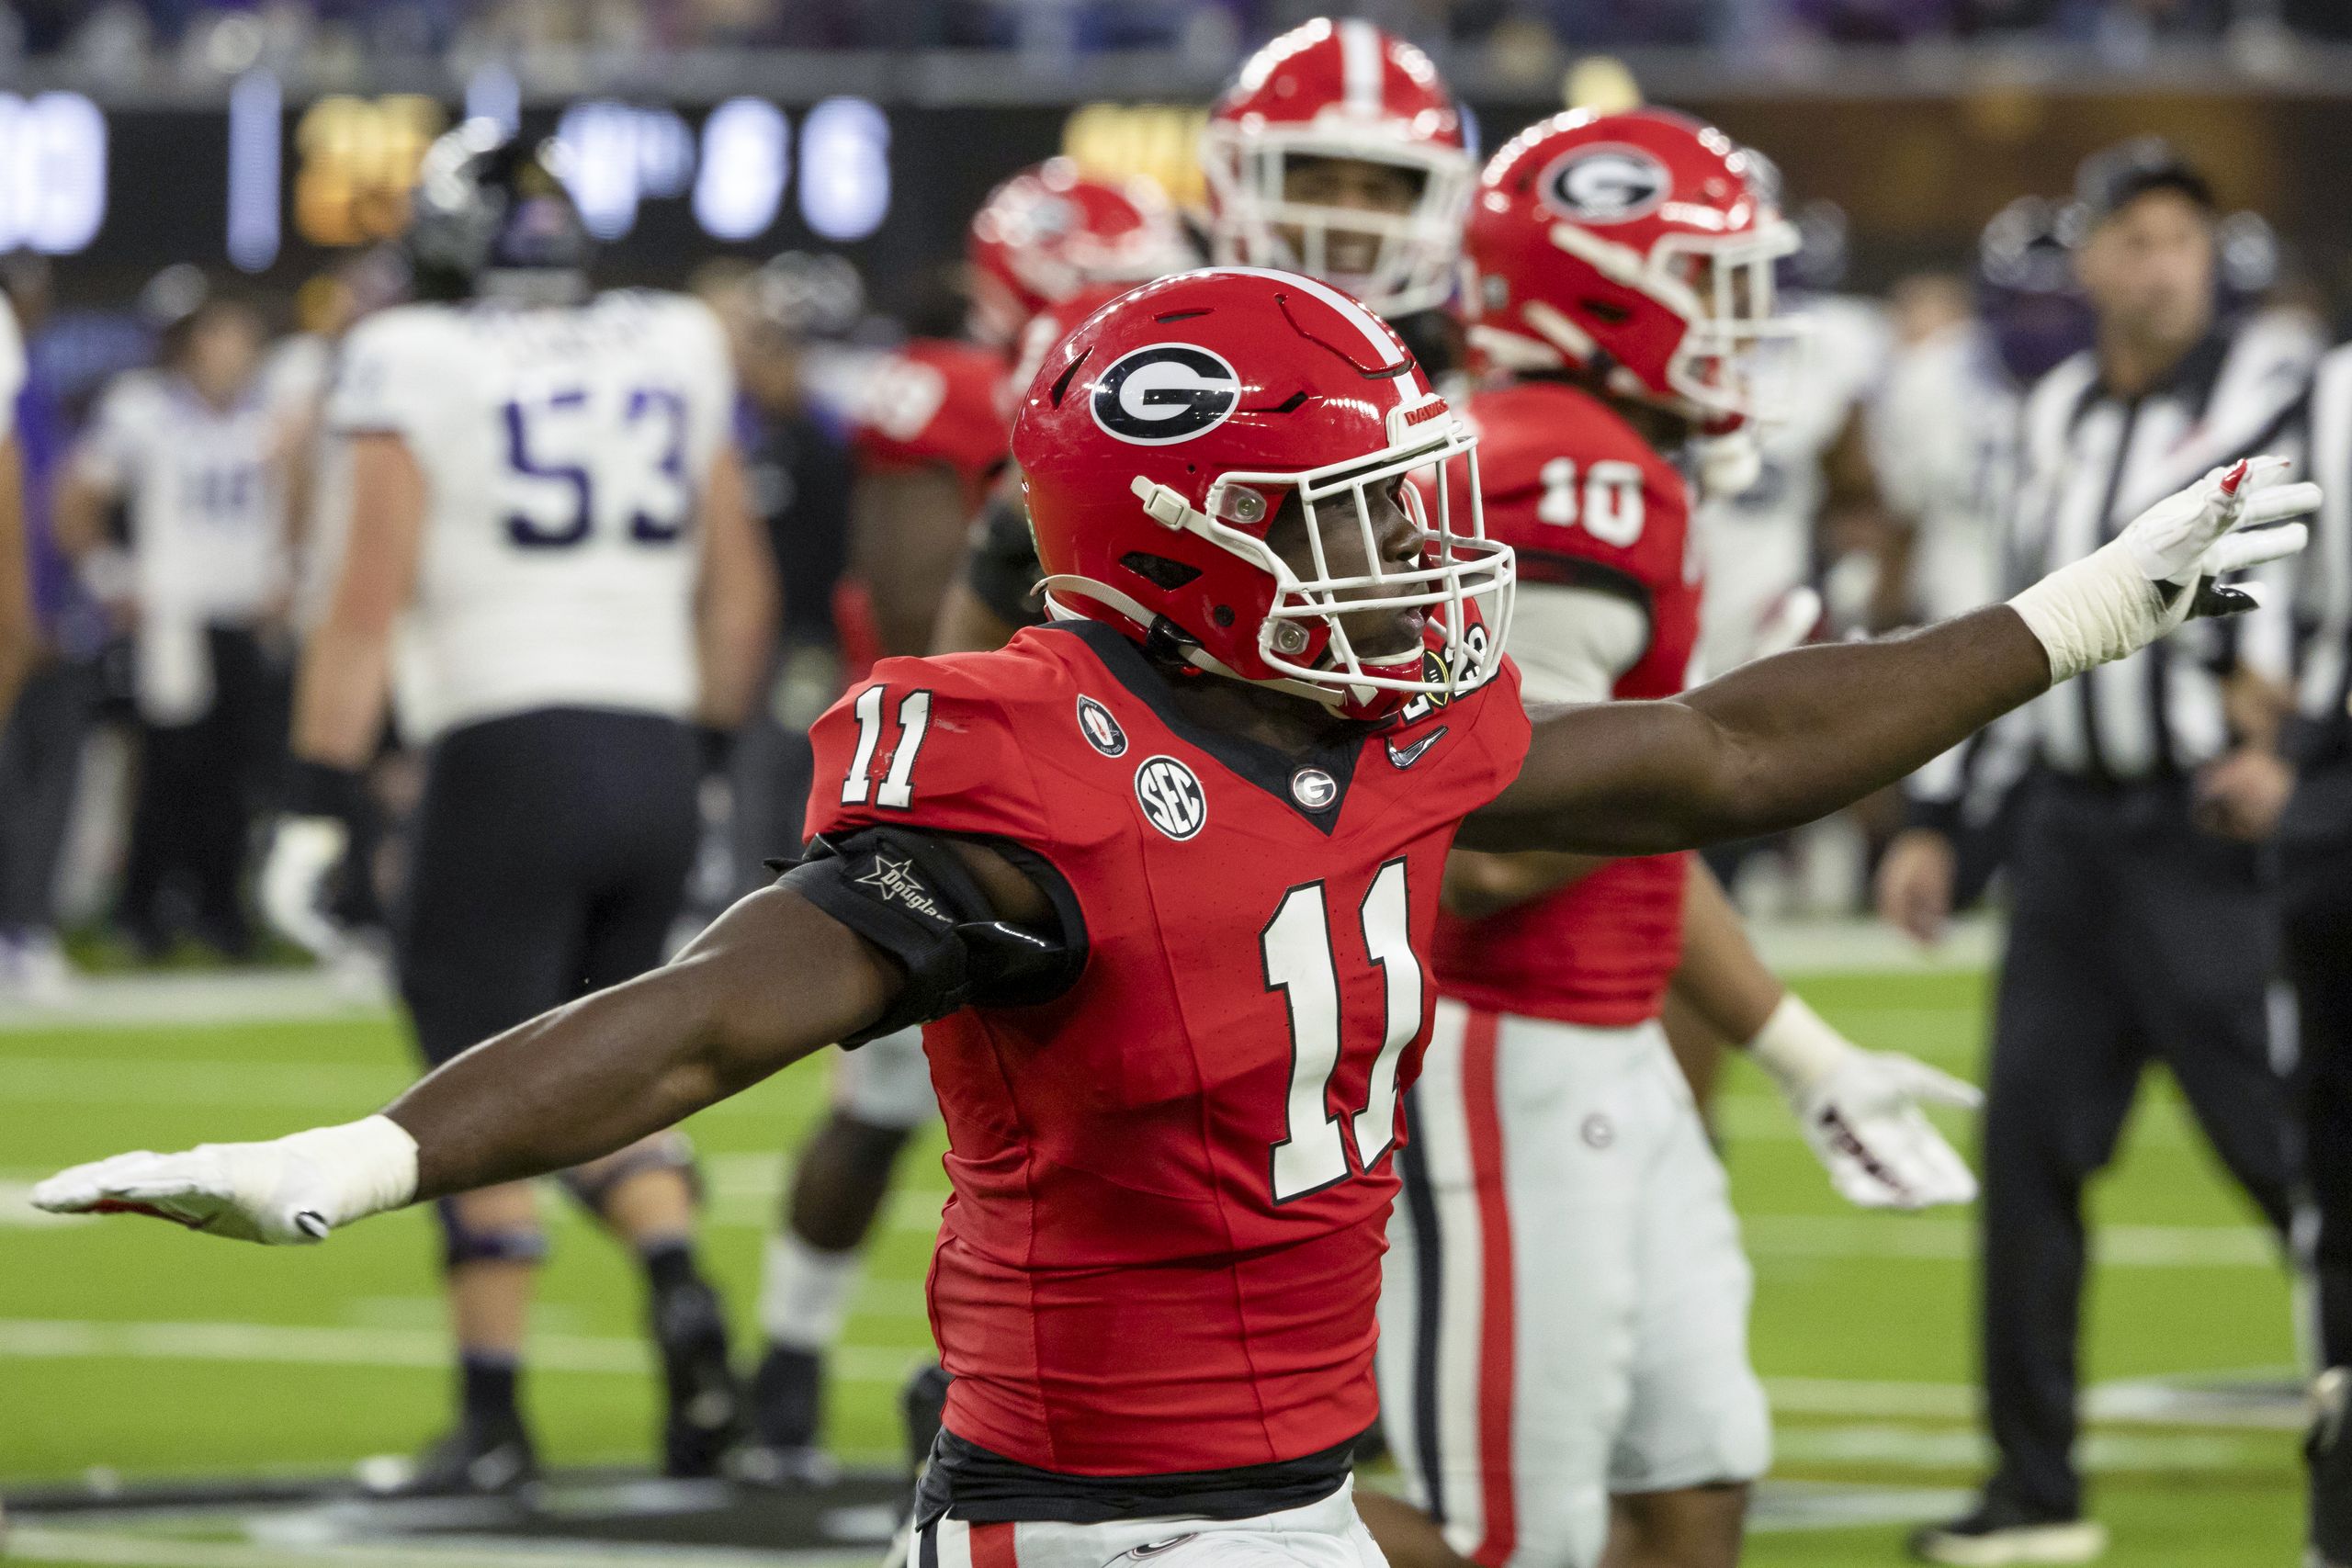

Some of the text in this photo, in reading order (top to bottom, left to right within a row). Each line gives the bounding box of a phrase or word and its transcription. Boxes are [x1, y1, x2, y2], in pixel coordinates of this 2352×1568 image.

[1110, 355, 1238, 430] G
[503, 389, 698, 551] 53
[1537, 457, 1645, 547] 10
[841, 684, 932, 811] 11
[1298, 773, 1334, 802] G
[1140, 761, 1201, 835] SEC
[1260, 855, 1424, 1205] 11
